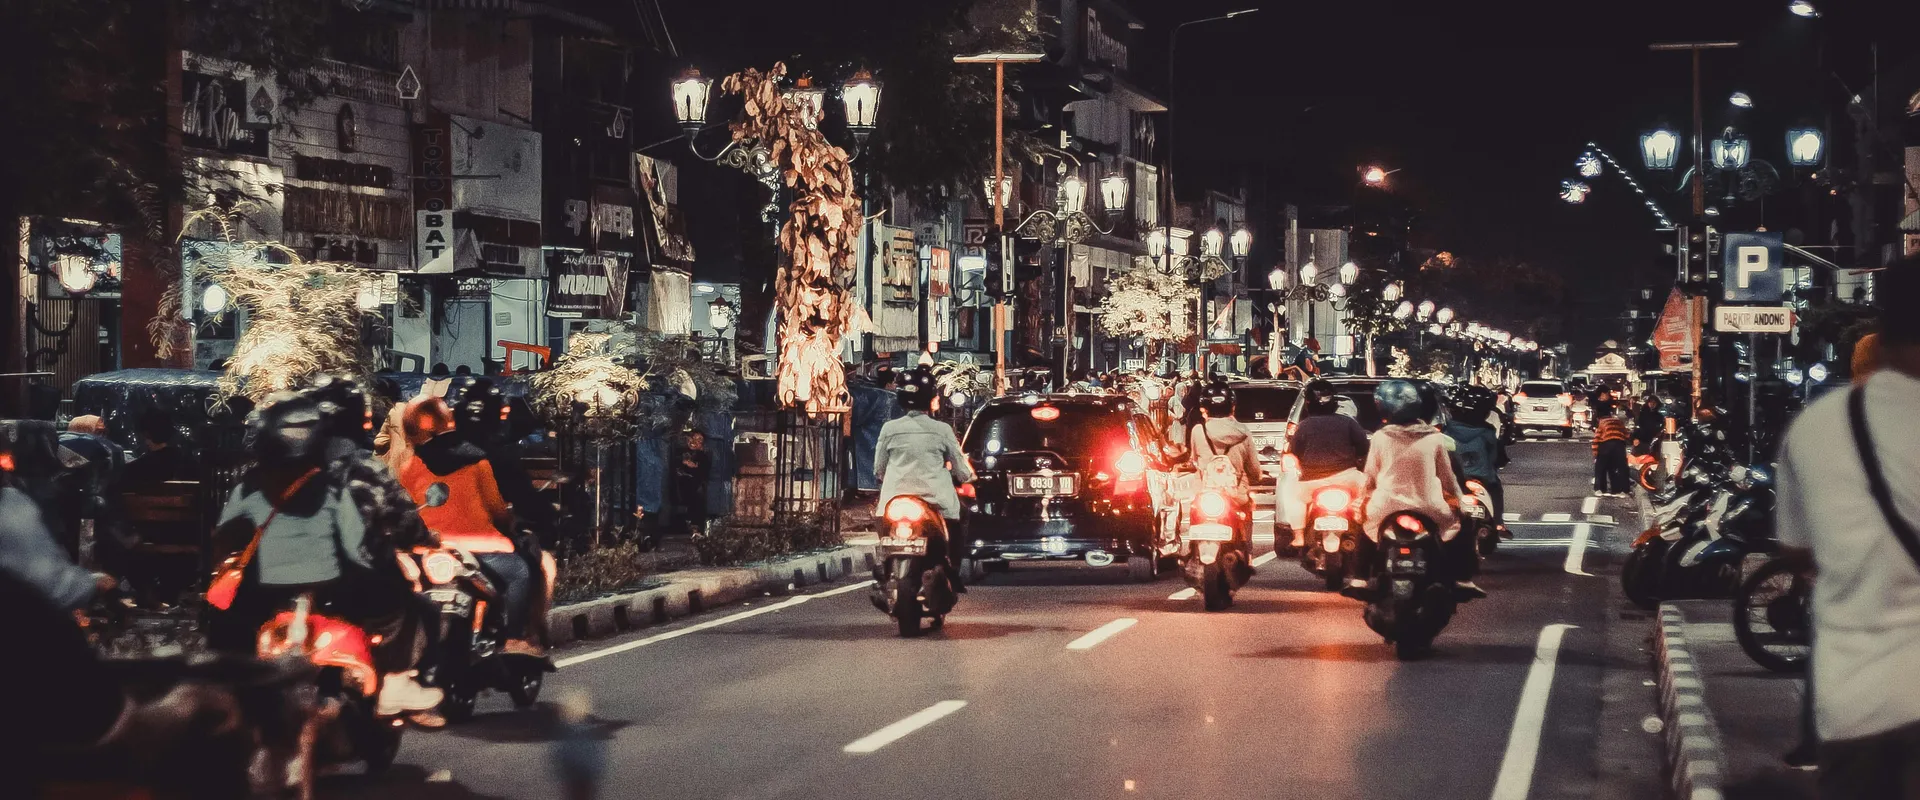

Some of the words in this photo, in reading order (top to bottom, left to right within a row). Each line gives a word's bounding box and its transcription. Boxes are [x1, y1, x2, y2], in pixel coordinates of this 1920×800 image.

[422, 128, 445, 192] TOKO
[424, 197, 446, 259] OBAT
[1737, 246, 1769, 289] P
[1723, 312, 1751, 325] PARKIR
[1753, 312, 1785, 325] ANDONG
